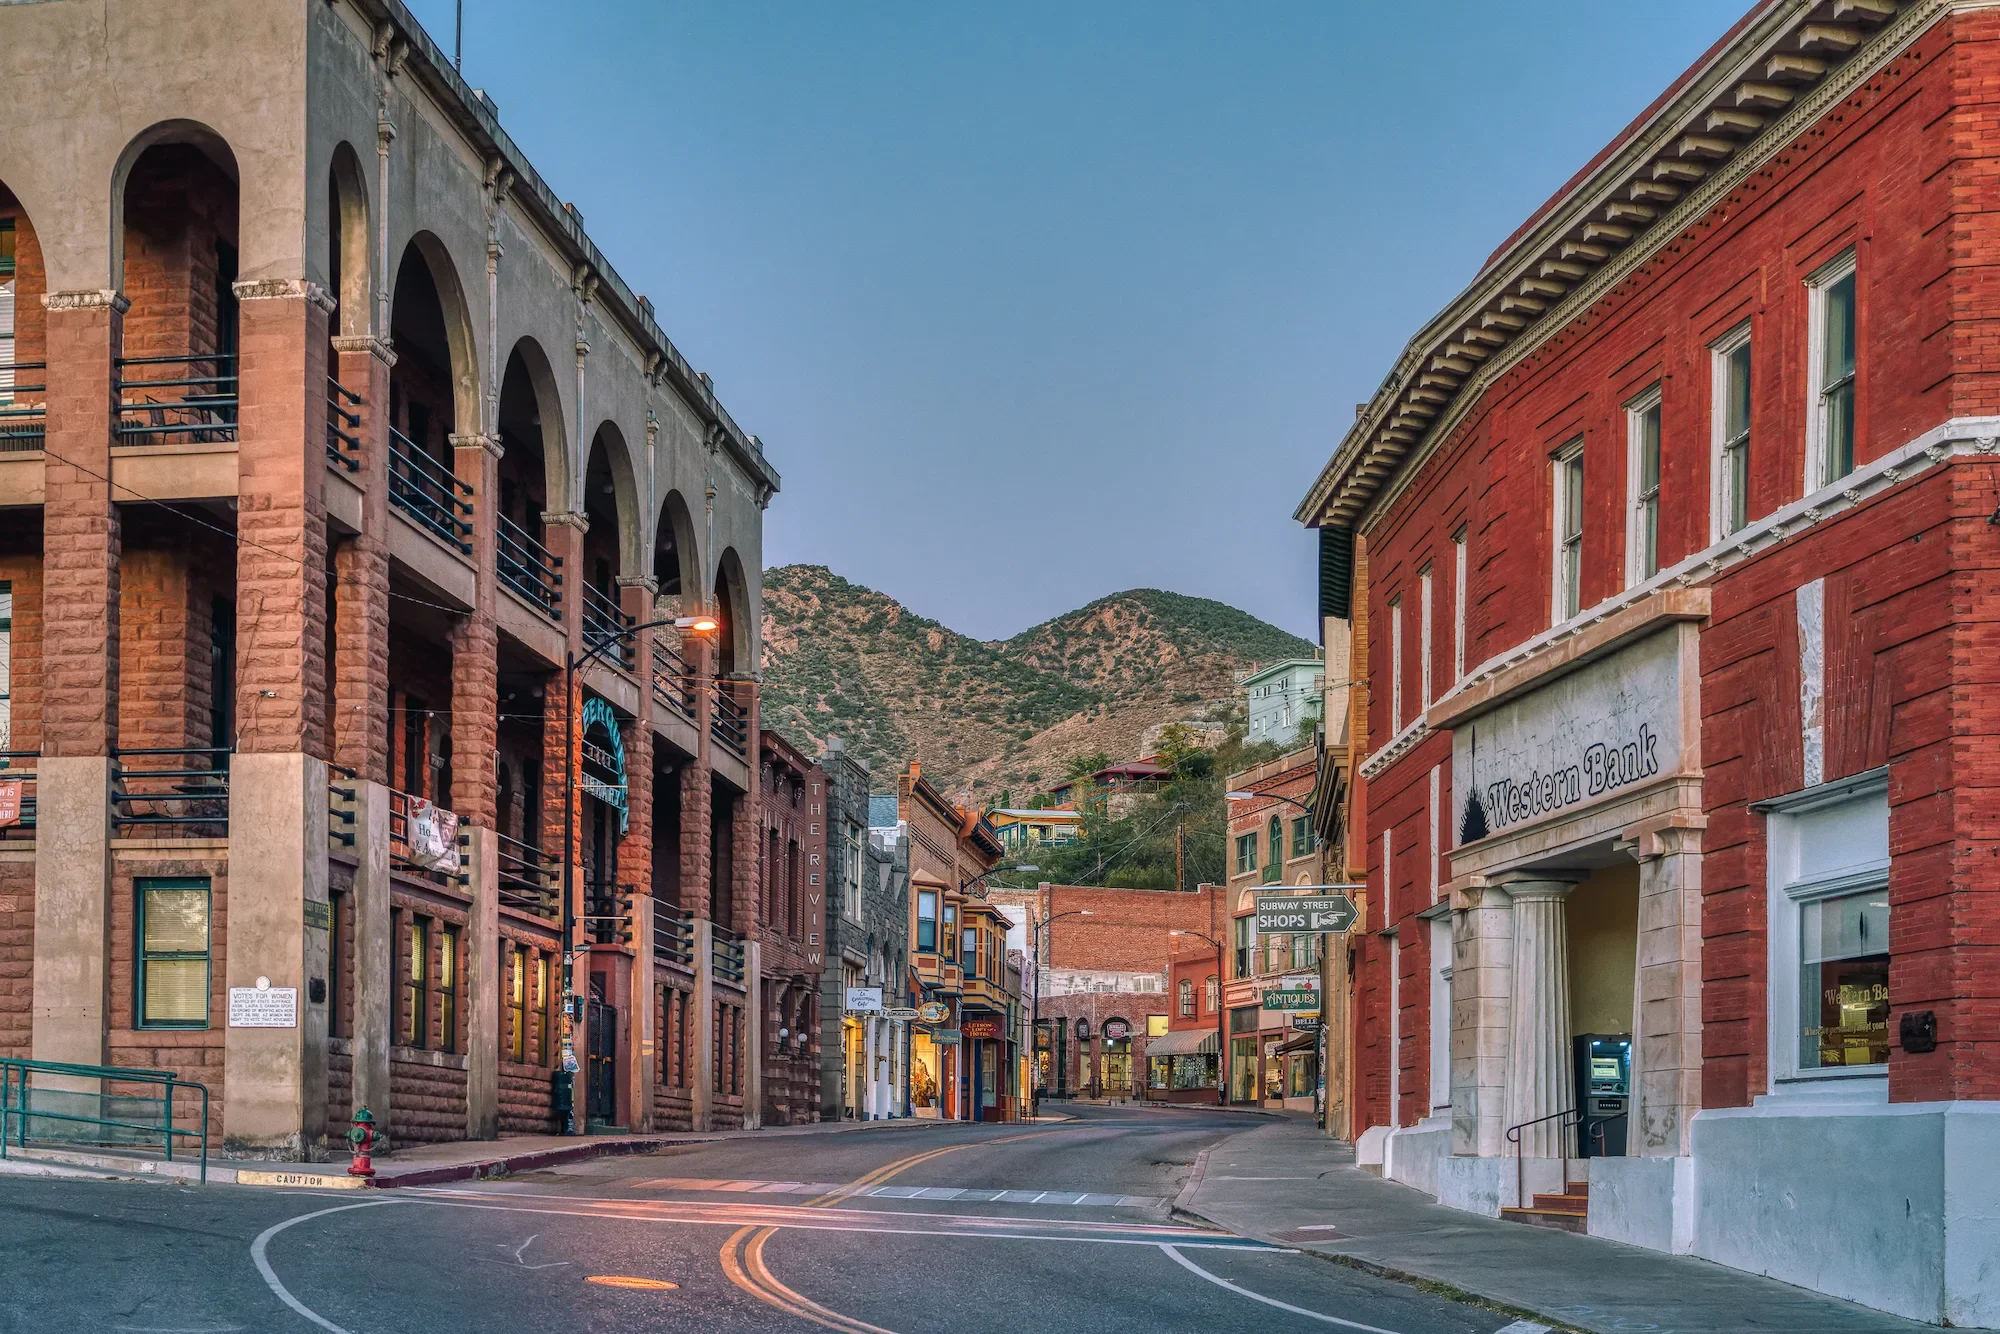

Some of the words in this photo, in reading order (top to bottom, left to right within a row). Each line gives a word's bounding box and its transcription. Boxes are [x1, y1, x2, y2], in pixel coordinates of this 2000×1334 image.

[1487, 765, 1581, 828] Western
[1584, 722, 1658, 796] Bank
[810, 783, 821, 835] THE
[808, 853, 821, 966] REVIEW
[1260, 901, 1299, 910] SUBWAY
[1303, 901, 1334, 909] STREET
[1260, 914, 1305, 927] SHOPS
[1266, 992, 1316, 1007] ANTIQUES
[1824, 988, 1870, 1005] Western
[1872, 984, 1889, 1000] Ba
[276, 1174, 322, 1186] CAUTION
